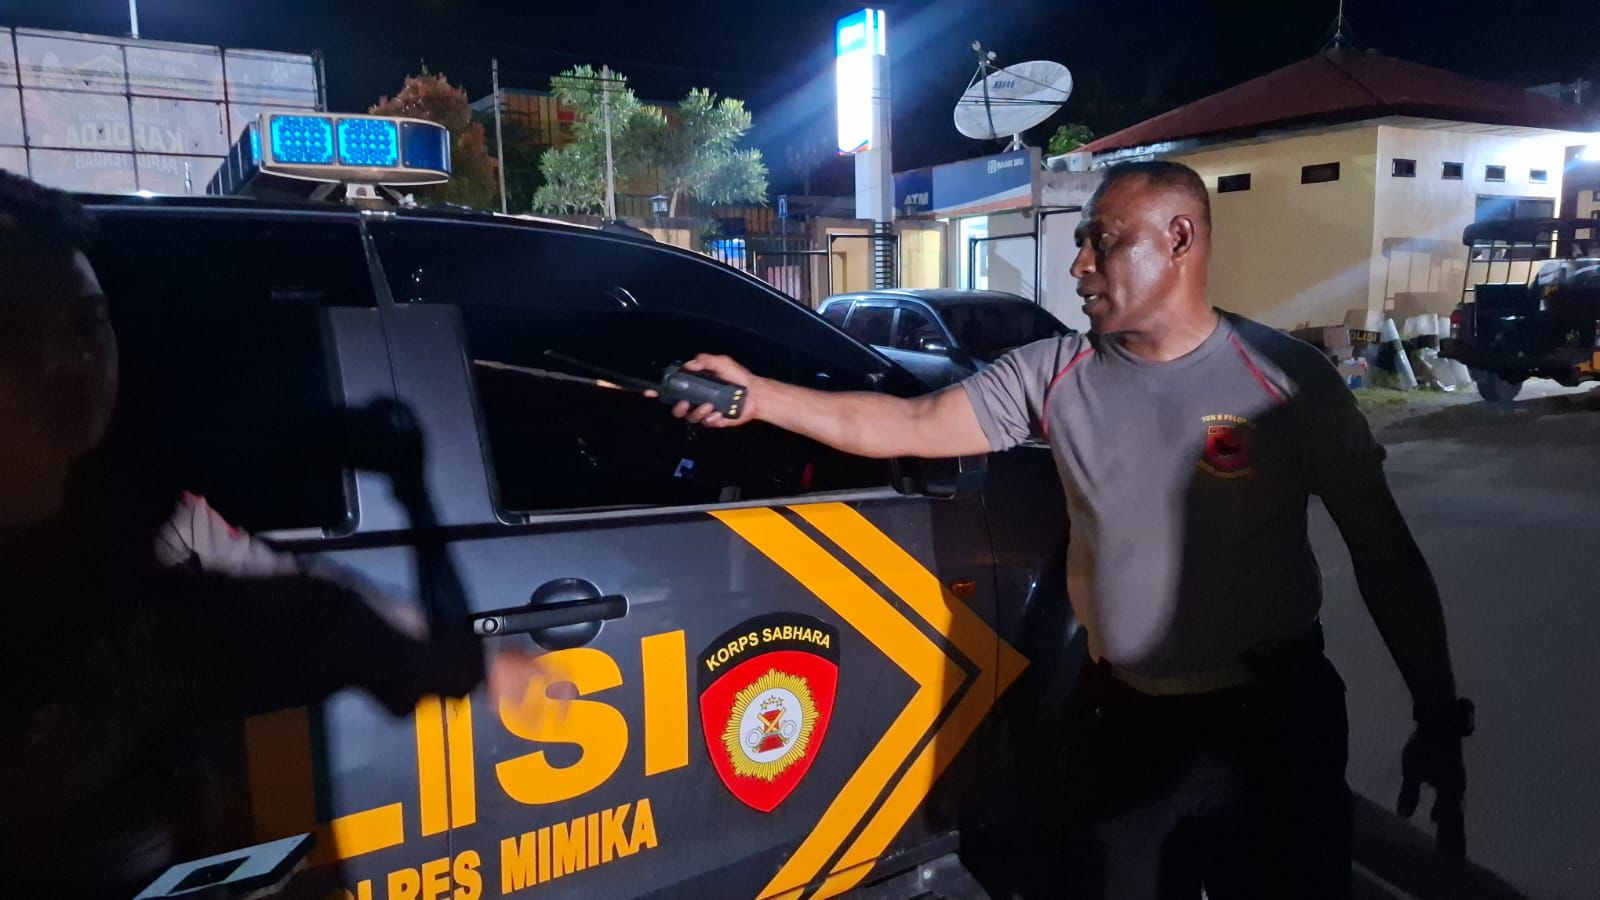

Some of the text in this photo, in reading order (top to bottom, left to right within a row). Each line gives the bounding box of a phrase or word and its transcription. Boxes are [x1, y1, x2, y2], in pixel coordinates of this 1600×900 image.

[992, 79, 1015, 89] BRI
[996, 159, 1013, 170] BANK
[904, 192, 929, 205] ATM
[1351, 330, 1376, 342] OLISI
[705, 626, 830, 672] KORPS SABHARA
[500, 797, 658, 895] MIMIKA
